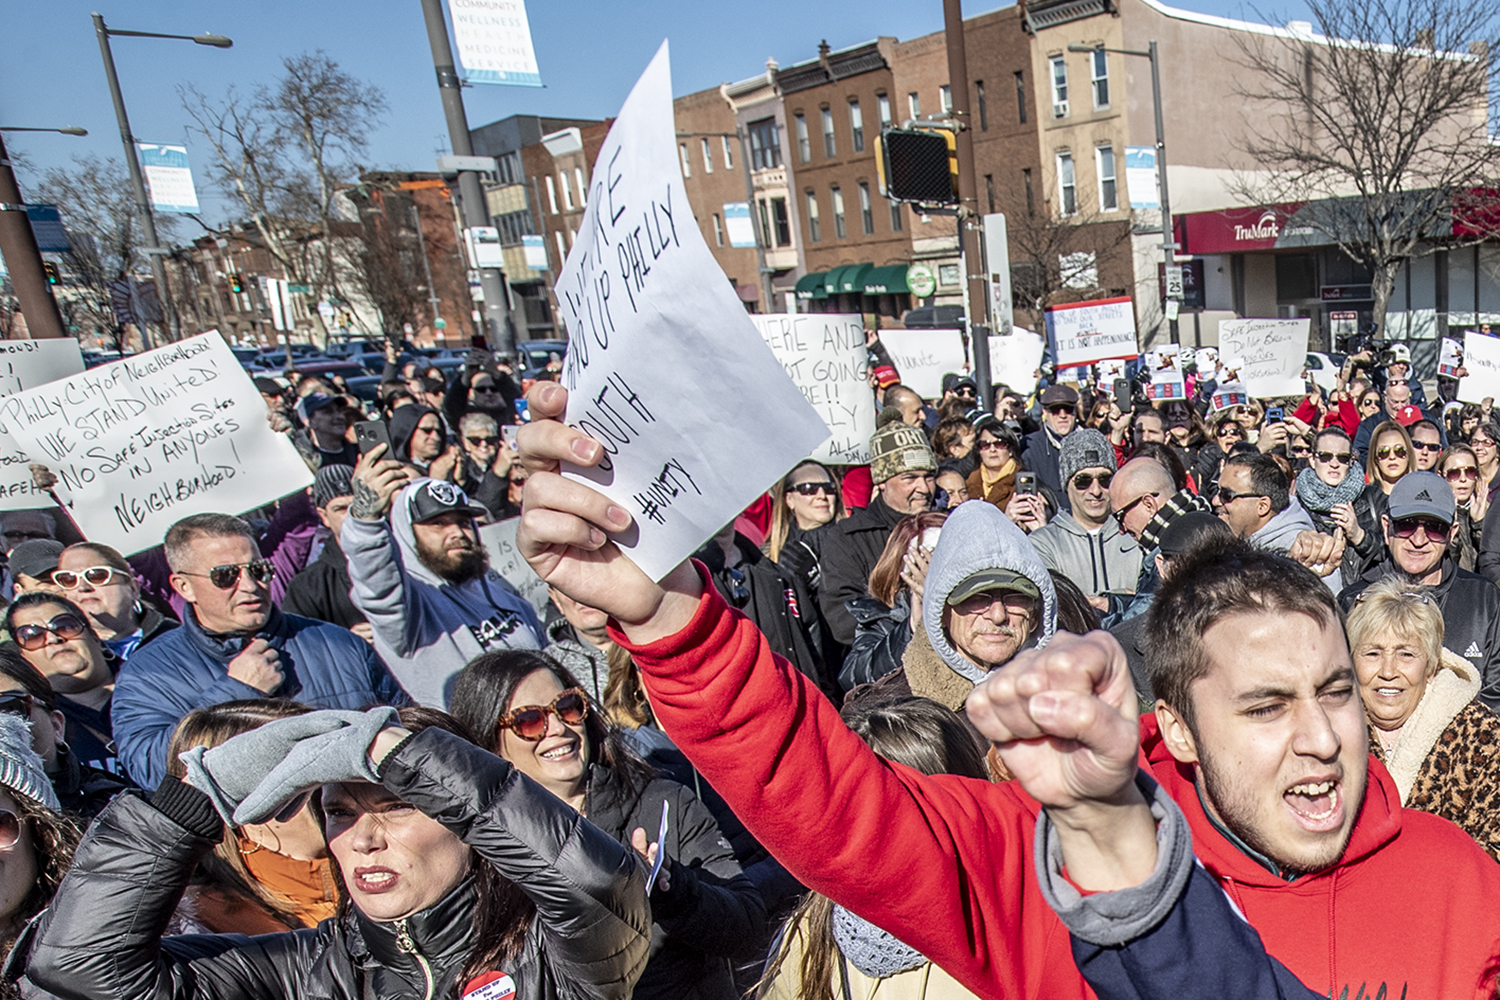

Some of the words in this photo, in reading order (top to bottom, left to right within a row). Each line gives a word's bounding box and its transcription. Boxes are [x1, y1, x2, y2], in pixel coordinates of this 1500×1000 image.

[457, 14, 522, 27] WELLNESS
[464, 44, 528, 57] MEDICINE
[468, 59, 530, 71] SERVICE
[1234, 213, 1279, 240] TruMark
[617, 182, 681, 313] PHILLY
[1169, 282, 1181, 292] 25
[822, 322, 865, 356] AND
[1068, 338, 1075, 350] IS
[812, 356, 868, 382] GOING
[74, 398, 147, 441] STAND
[36, 428, 77, 463] WE
[829, 437, 861, 457] ALL
[60, 463, 96, 492] NO
[130, 457, 152, 480] IN
